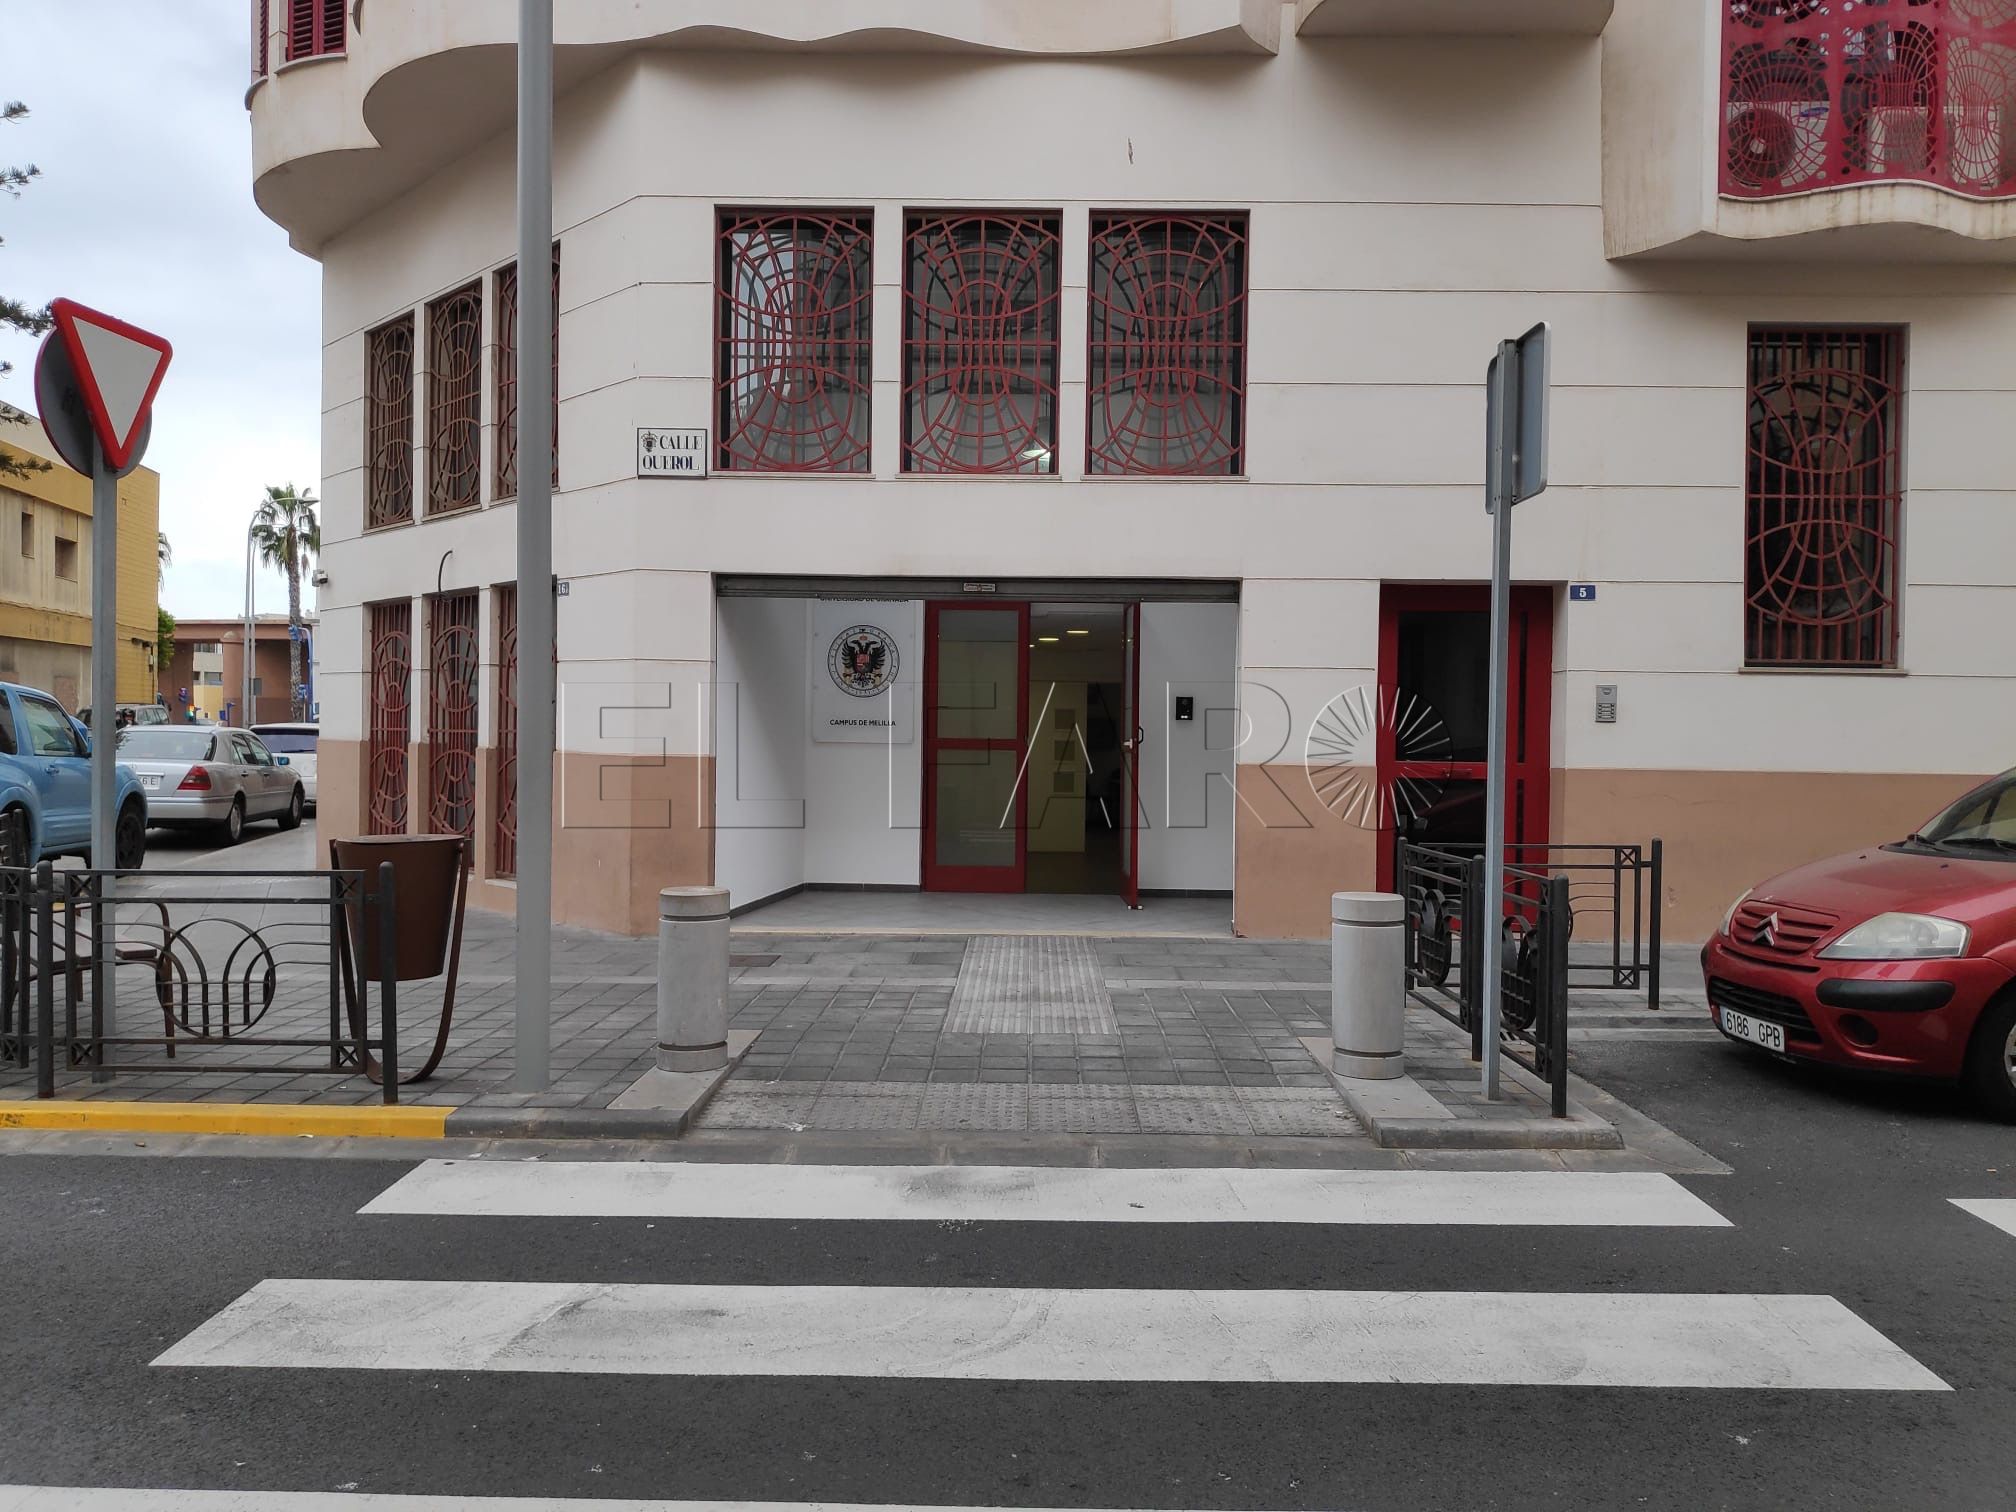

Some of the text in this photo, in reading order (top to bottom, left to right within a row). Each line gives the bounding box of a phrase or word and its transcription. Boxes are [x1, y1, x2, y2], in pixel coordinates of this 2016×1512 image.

[659, 435, 703, 450] CALLE
[642, 455, 700, 471] QUEROL
[1579, 587, 1587, 598] 5
[868, 719, 897, 727] MELILLA
[1726, 1011, 1781, 1048] 6186 GPB
